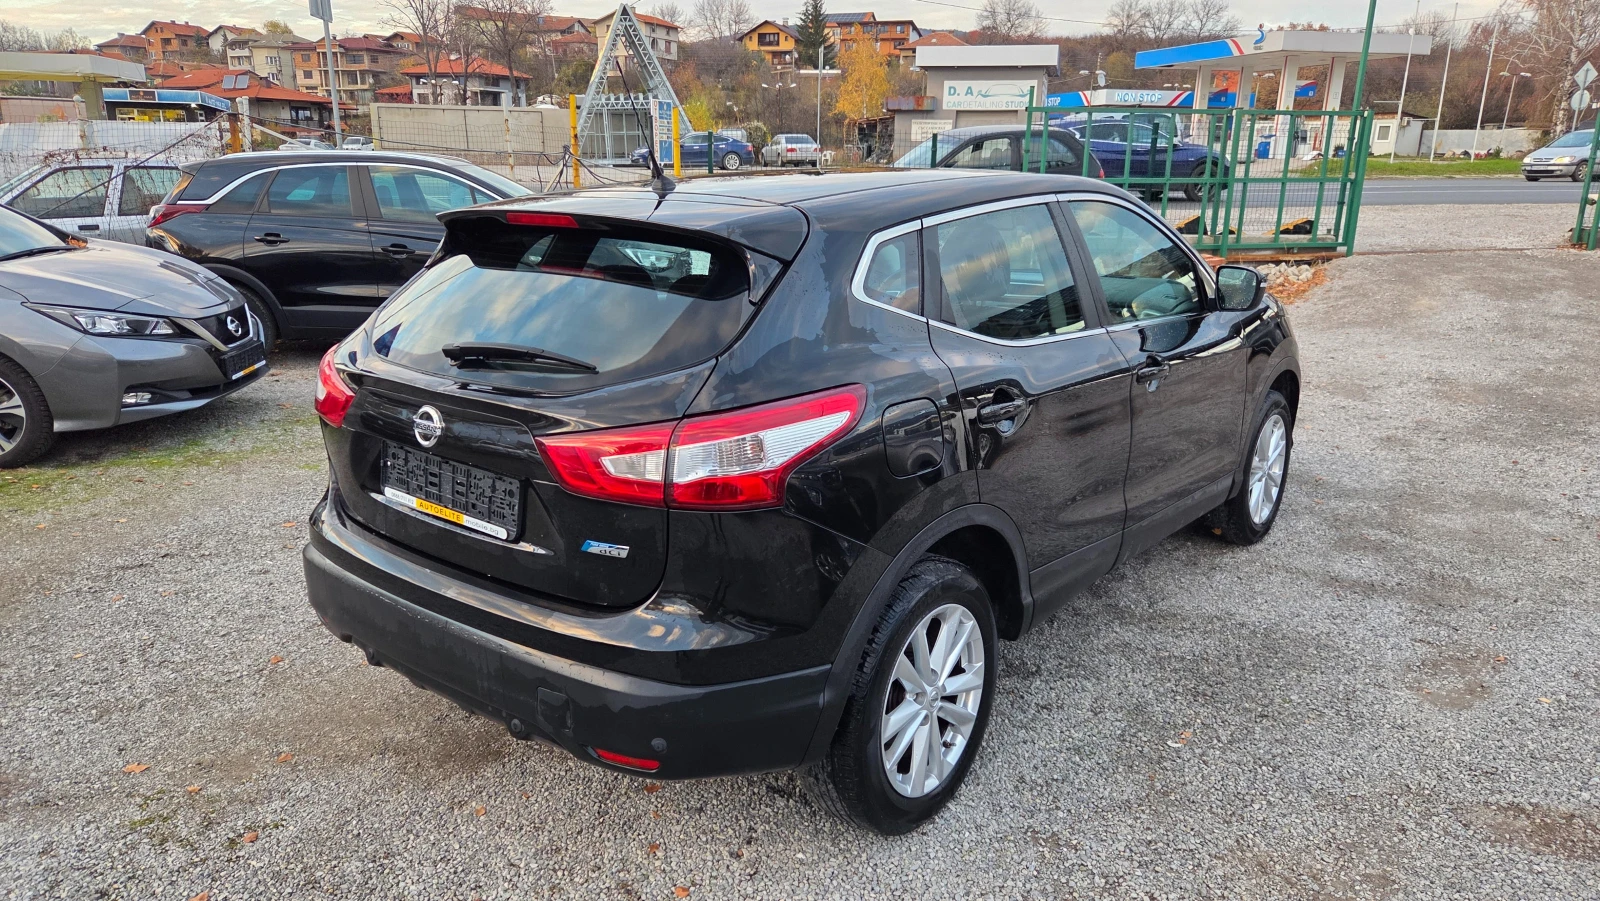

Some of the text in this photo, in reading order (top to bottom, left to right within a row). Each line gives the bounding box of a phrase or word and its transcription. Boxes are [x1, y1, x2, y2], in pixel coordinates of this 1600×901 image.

[948, 86, 974, 97] D. A
[1047, 96, 1061, 107] STOP
[1115, 92, 1163, 104] NON STOP
[419, 502, 461, 522] AUTOELITE
